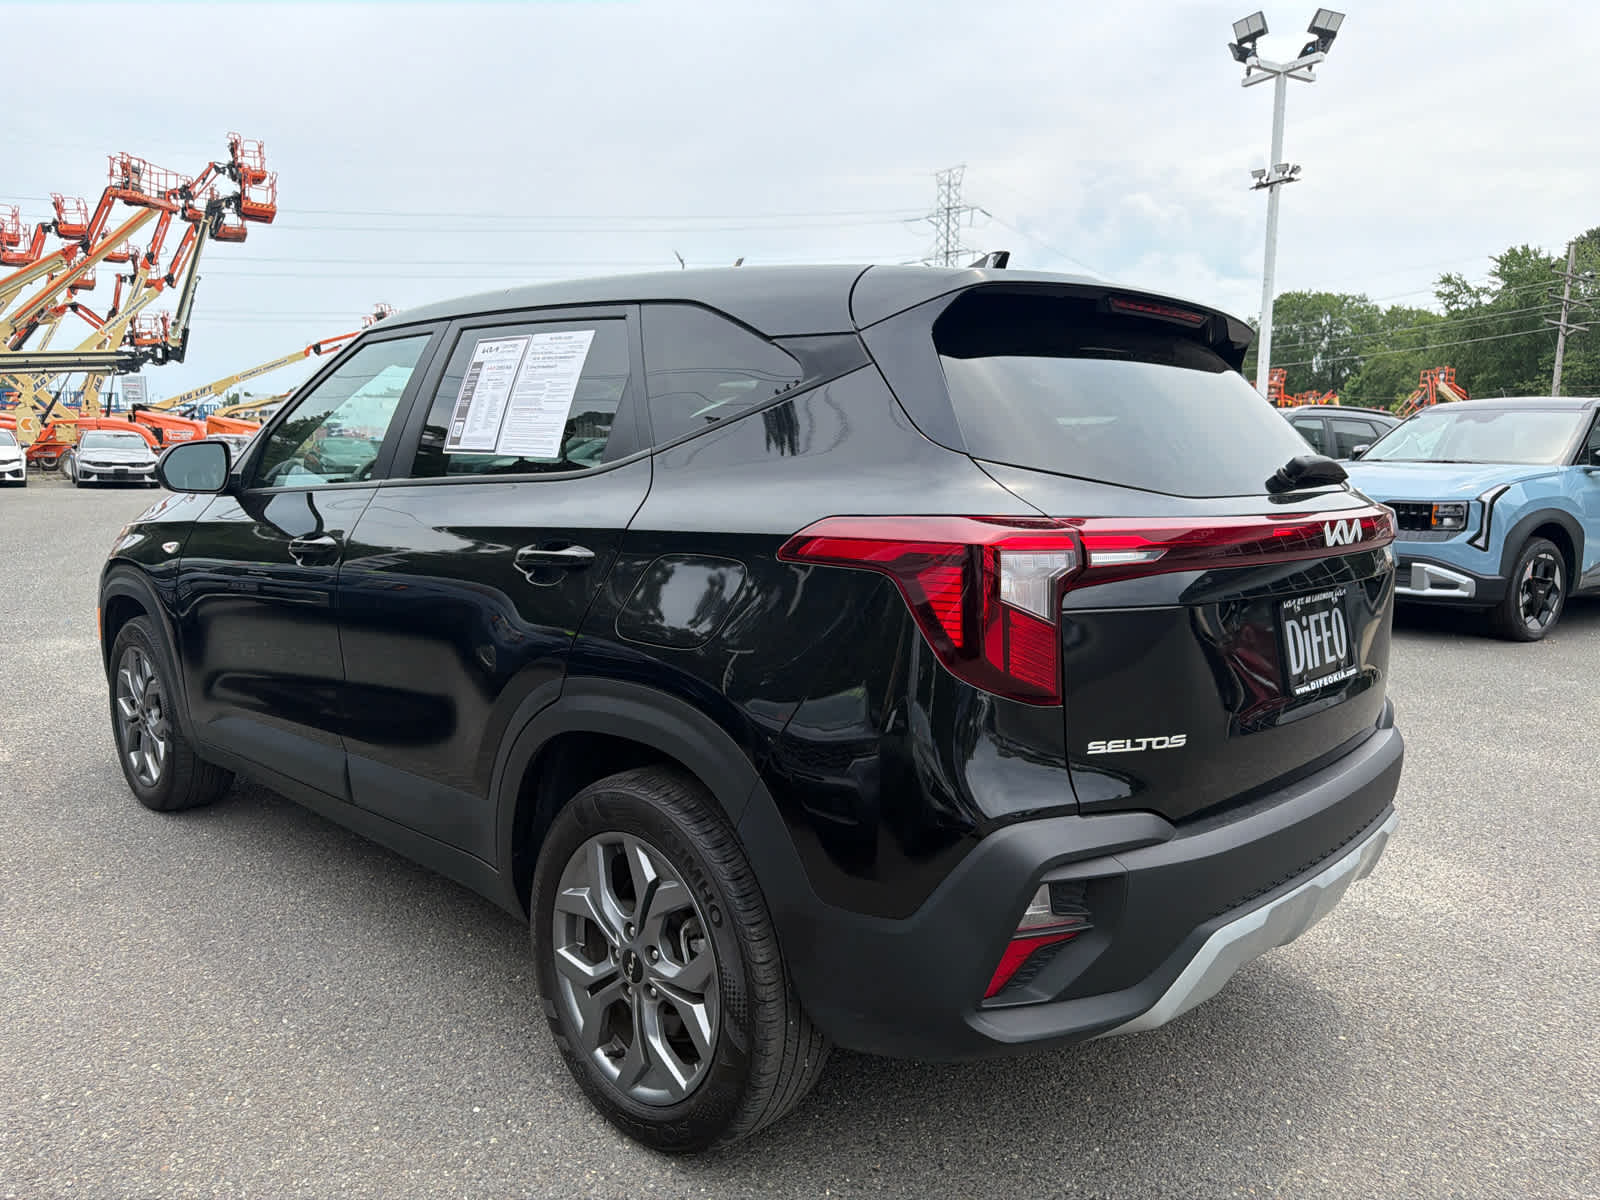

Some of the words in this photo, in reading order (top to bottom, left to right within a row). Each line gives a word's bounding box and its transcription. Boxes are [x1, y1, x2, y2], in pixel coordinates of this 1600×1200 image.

[195, 385, 213, 397] LIFT
[1324, 518, 1363, 547] KIA
[1087, 734, 1187, 755] SELTOS
